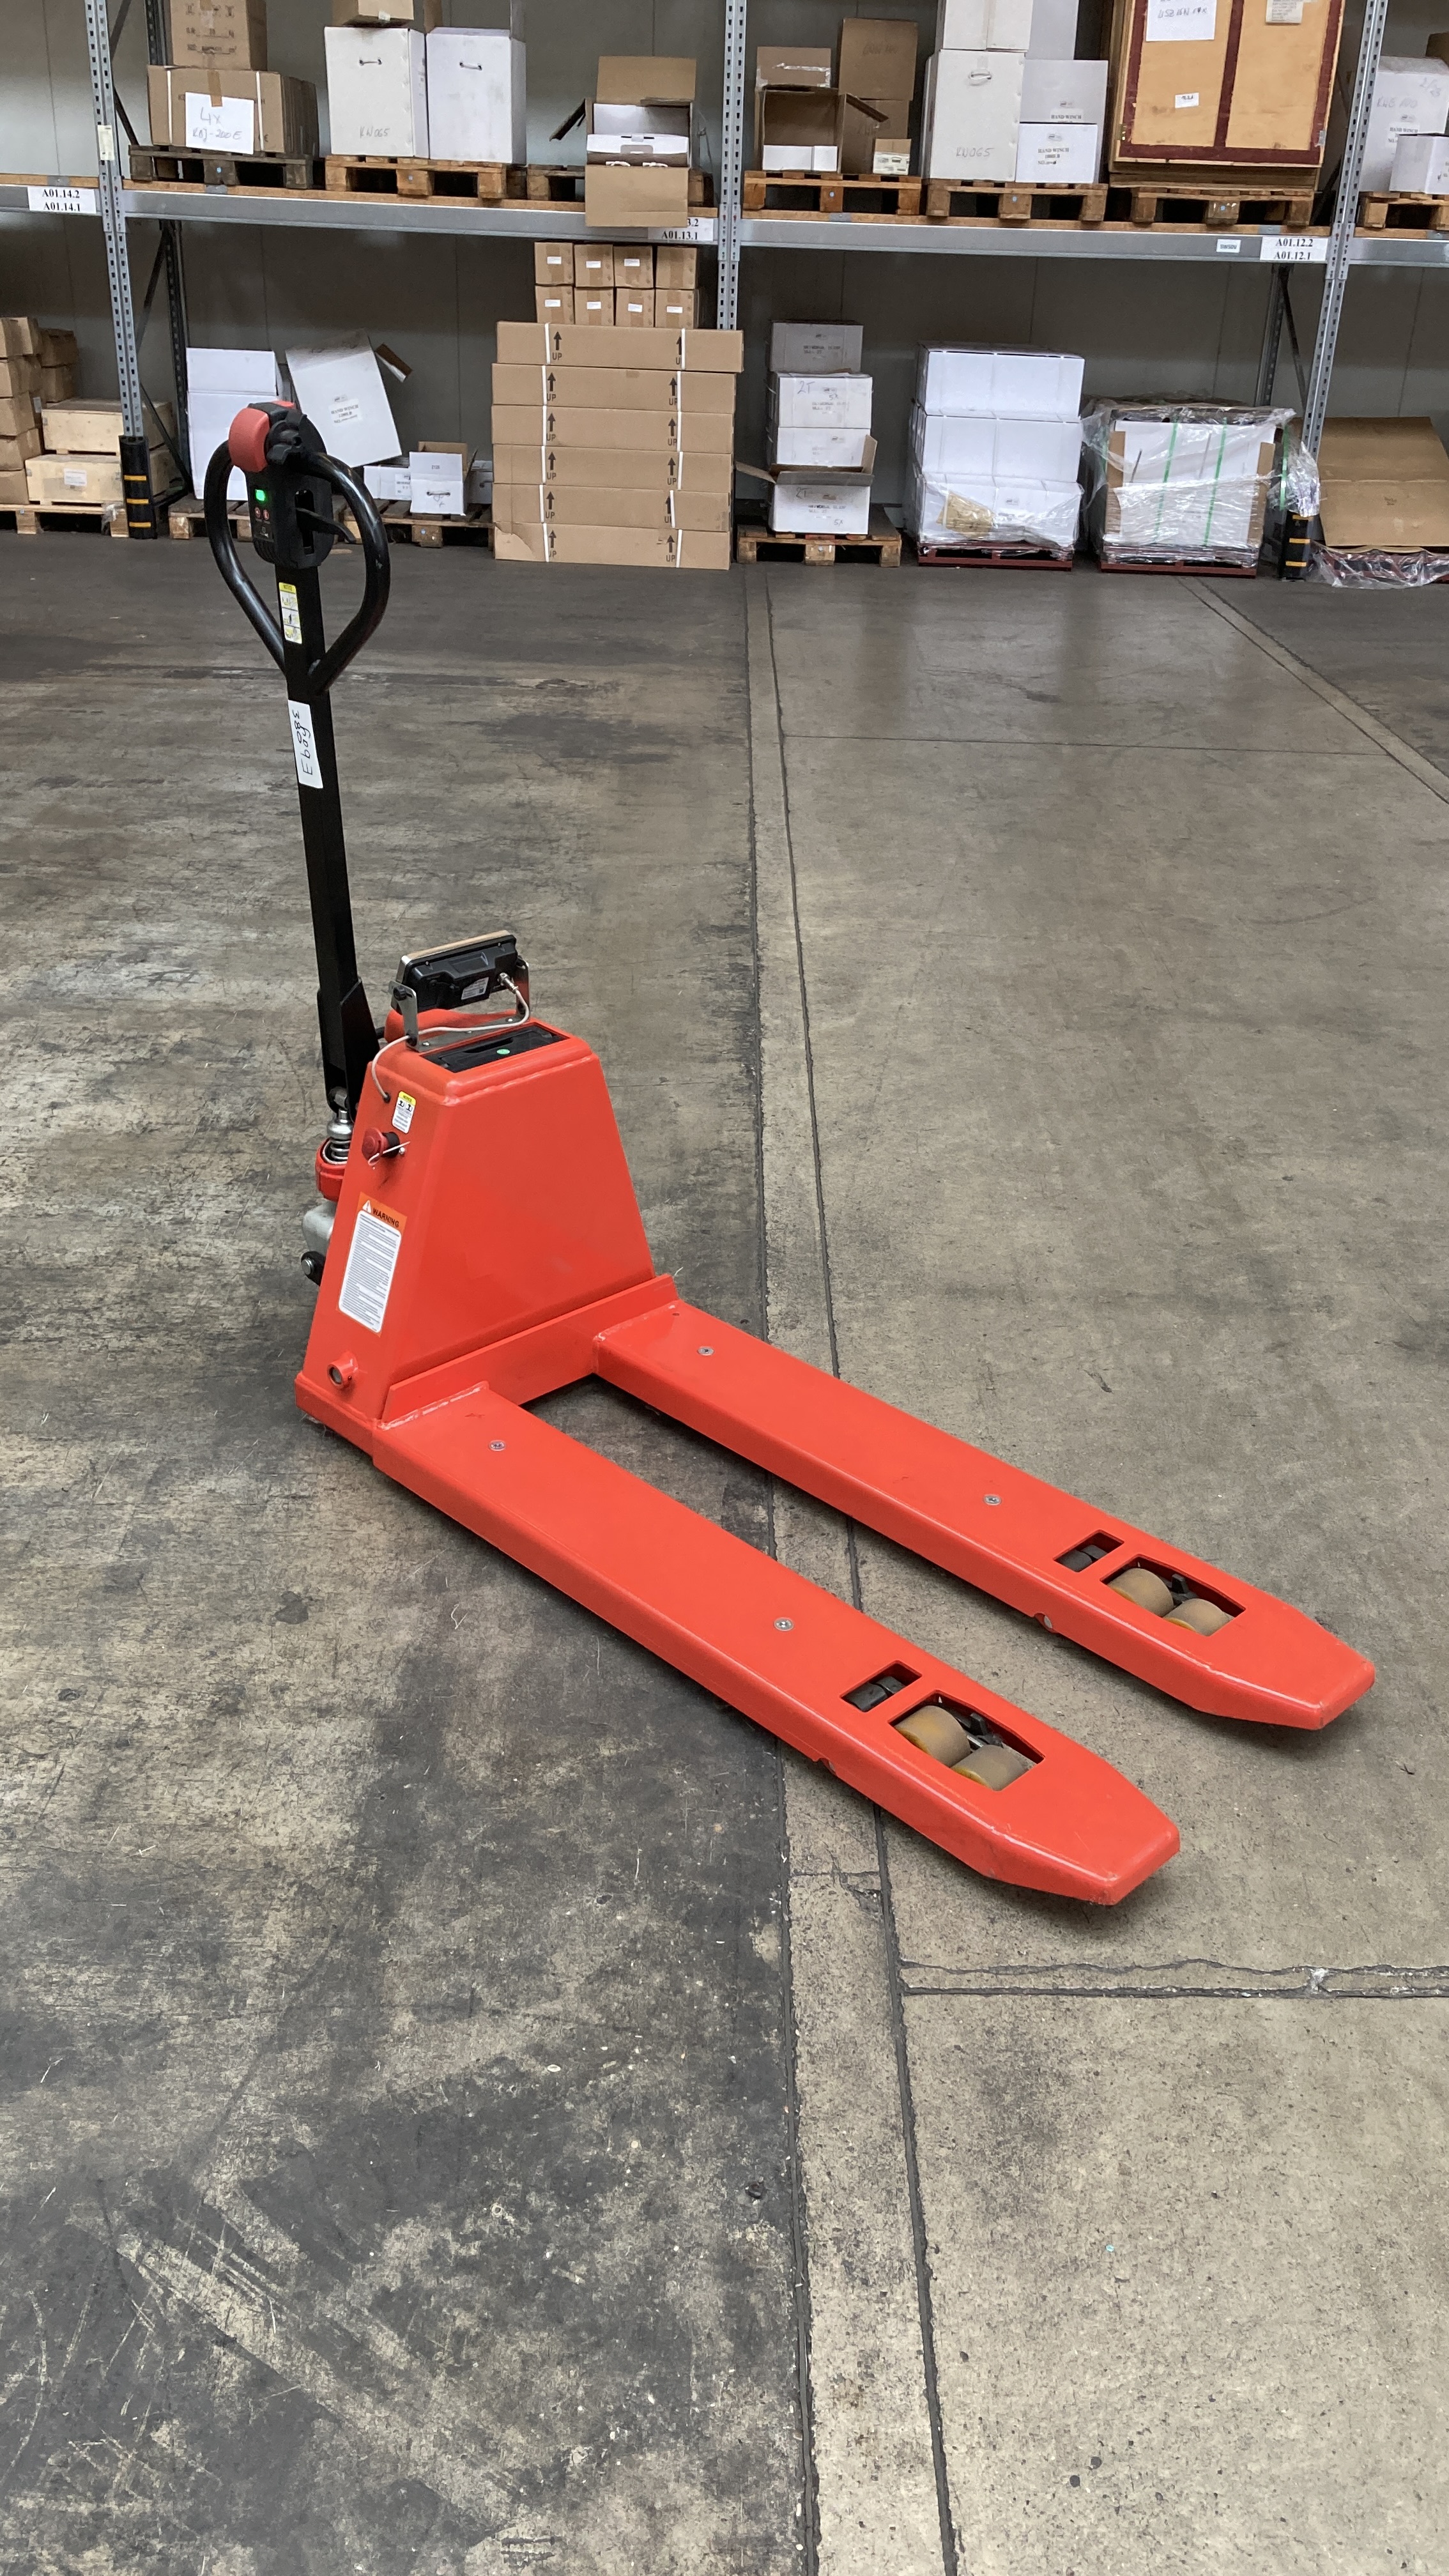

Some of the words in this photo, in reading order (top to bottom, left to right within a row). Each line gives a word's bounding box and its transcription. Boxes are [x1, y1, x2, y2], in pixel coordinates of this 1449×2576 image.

[42, 188, 80, 199] A01.14.2
[43, 201, 80, 212] A01.14.1
[661, 230, 698, 240] A01.13.1
[1275, 238, 1313, 247] A01.12.2
[1274, 251, 1310, 261] A01.12.1
[552, 352, 562, 360] UP
[546, 393, 556, 401] UP
[668, 438, 677, 447] UP
[546, 471, 556, 480] UP
[667, 477, 677, 486] UP
[372, 1207, 400, 1229] WARNING
